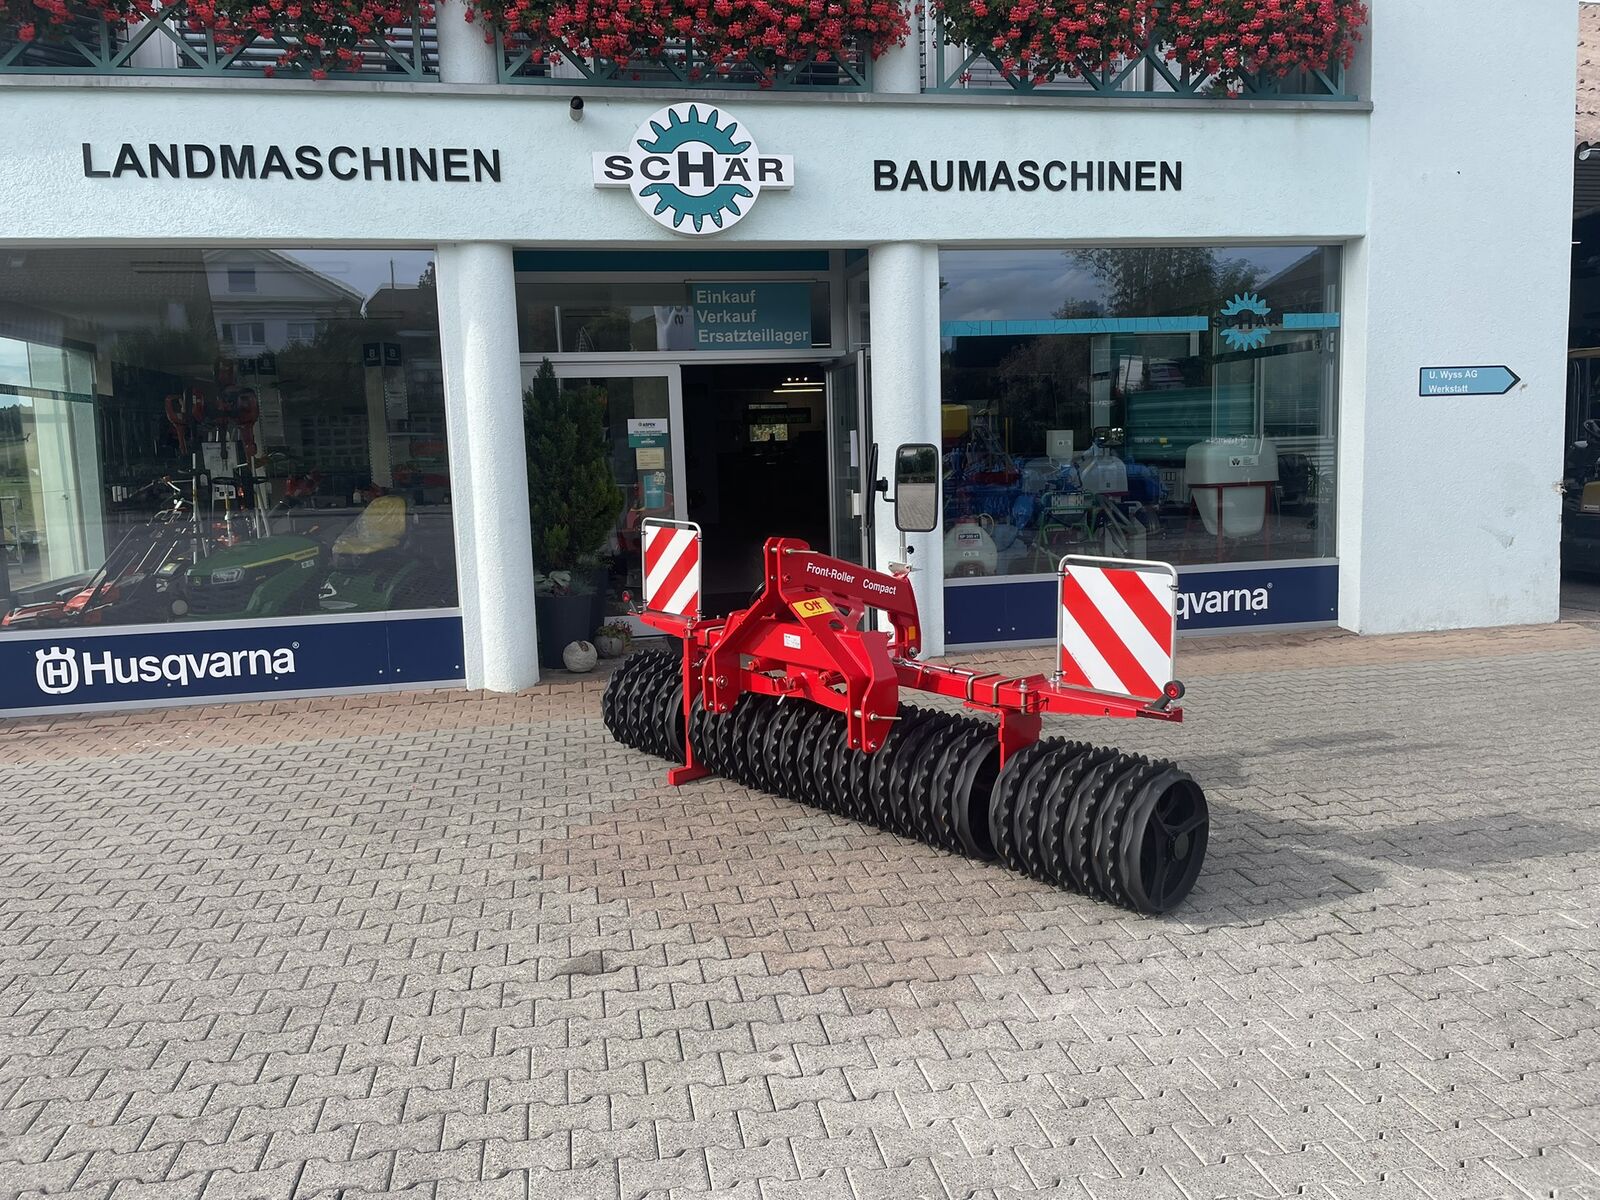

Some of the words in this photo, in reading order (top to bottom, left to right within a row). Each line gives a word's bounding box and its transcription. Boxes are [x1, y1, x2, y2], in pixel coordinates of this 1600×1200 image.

[81, 142, 502, 183] LANDMASCHINEN
[603, 151, 785, 187] SCHÄR
[873, 159, 1183, 192] BAUMASCHINEN
[696, 289, 757, 304] Einkauf
[696, 309, 757, 324] Verkauf
[698, 328, 809, 345] Ersatzteillager
[1429, 371, 1438, 379] U.
[1440, 370, 1463, 381] Wyss
[1465, 370, 1478, 379] AG
[1428, 384, 1469, 394] Werkstatt
[806, 562, 856, 584] Front-Roller
[862, 578, 897, 596] Compact
[803, 600, 823, 612] Ott
[1177, 587, 1269, 620] qvarna
[83, 647, 296, 686] Husqvarna
